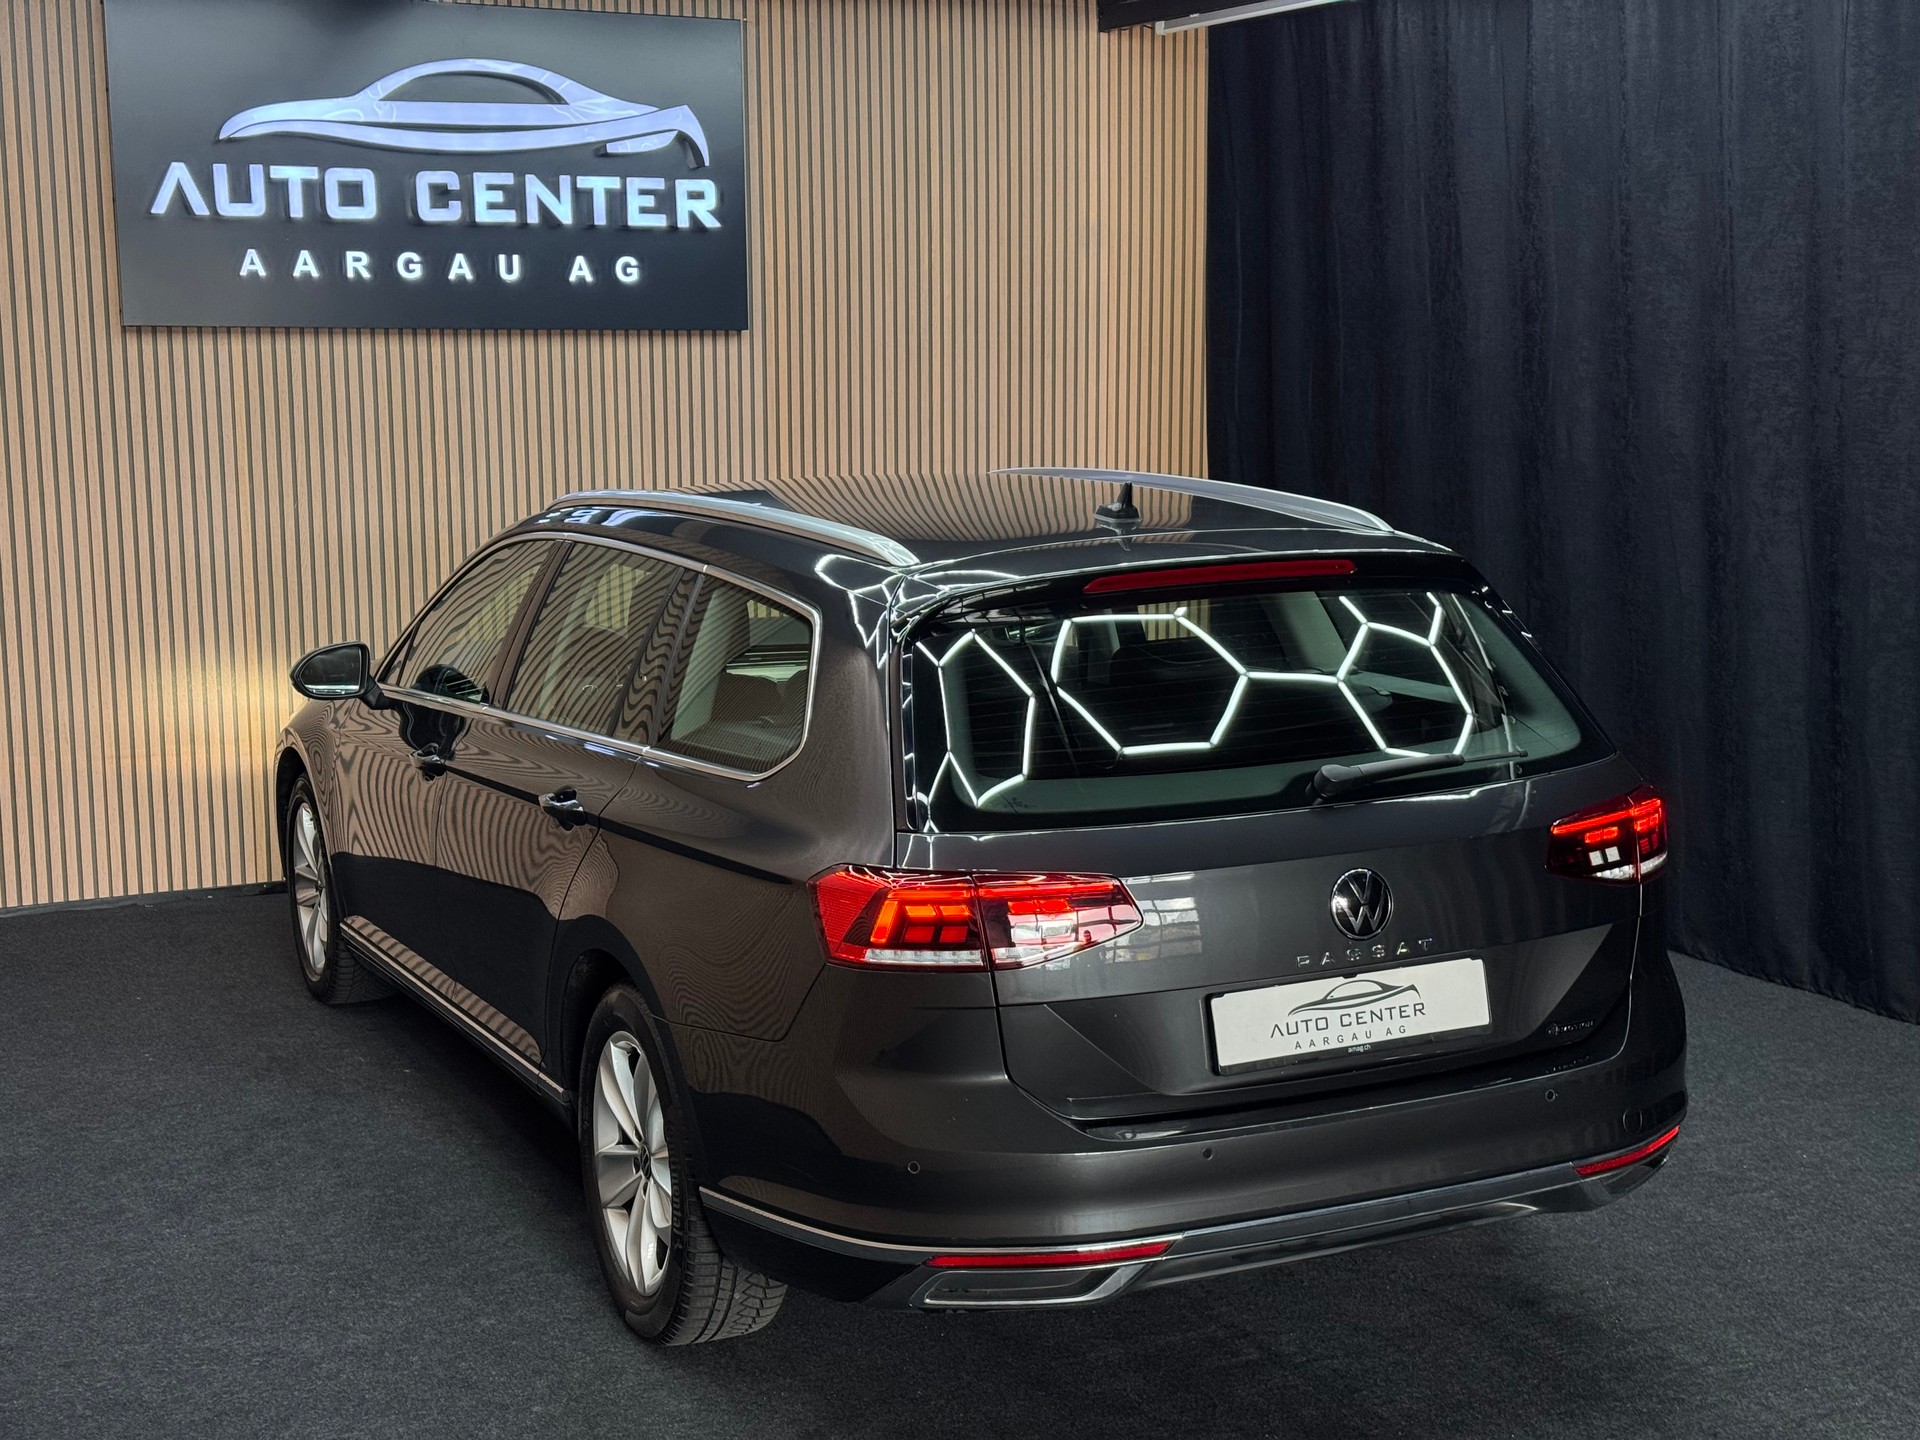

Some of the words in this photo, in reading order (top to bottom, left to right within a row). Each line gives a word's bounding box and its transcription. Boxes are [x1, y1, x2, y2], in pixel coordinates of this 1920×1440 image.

[150, 161, 378, 222] AUTO
[415, 170, 722, 229] CENTER
[239, 248, 521, 283] AARGAU
[568, 254, 641, 284] AG
[1295, 937, 1434, 968] PASSAT
[1270, 1016, 1329, 1038] AUTO
[1340, 1002, 1426, 1028] CENTER
[1294, 1030, 1372, 1050] AARGAU
[1385, 1025, 1406, 1037] AG
